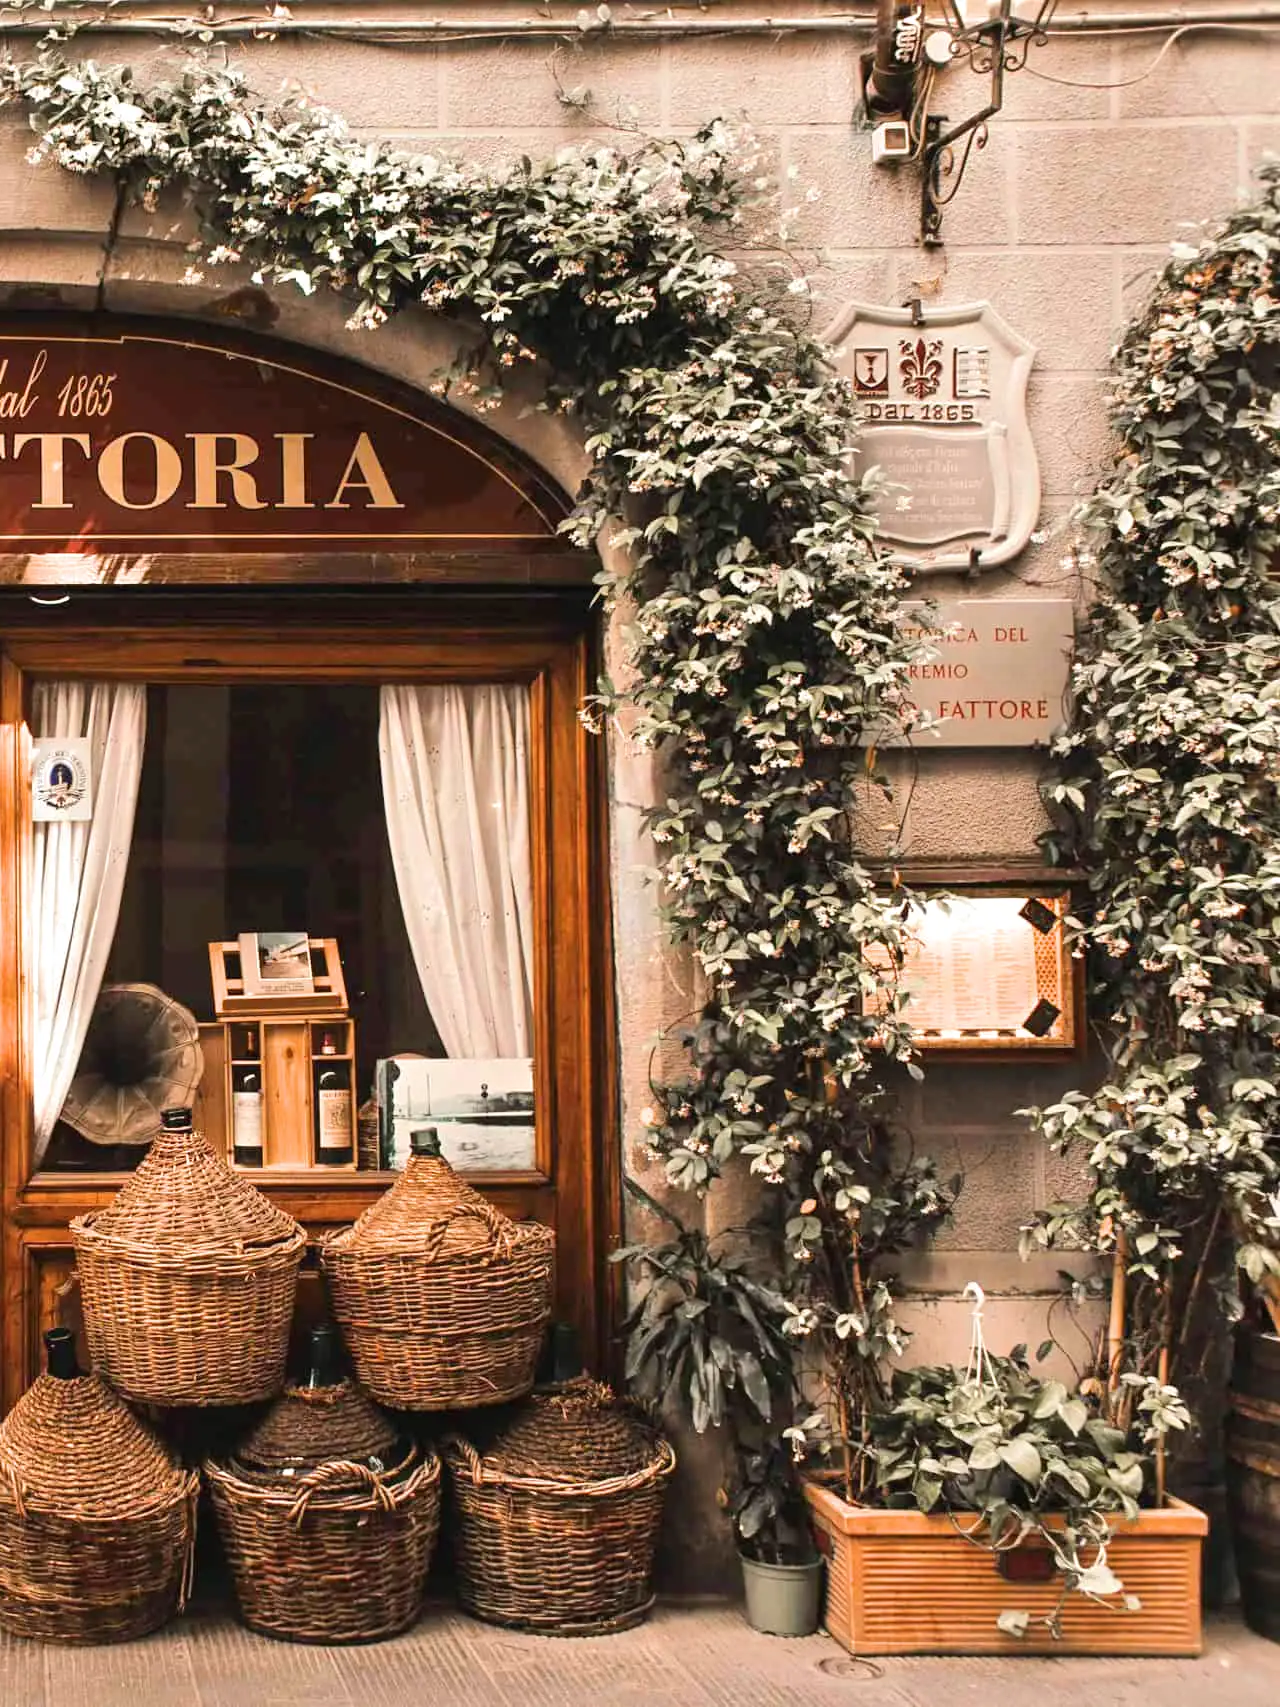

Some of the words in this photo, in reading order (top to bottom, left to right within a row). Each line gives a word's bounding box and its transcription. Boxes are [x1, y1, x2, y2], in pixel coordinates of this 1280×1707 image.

[57, 373, 118, 419] 1865
[920, 404, 975, 421] 1865
[994, 627, 1029, 642] DEL
[899, 663, 969, 680] REMIO
[939, 699, 1049, 719] FATTORE
